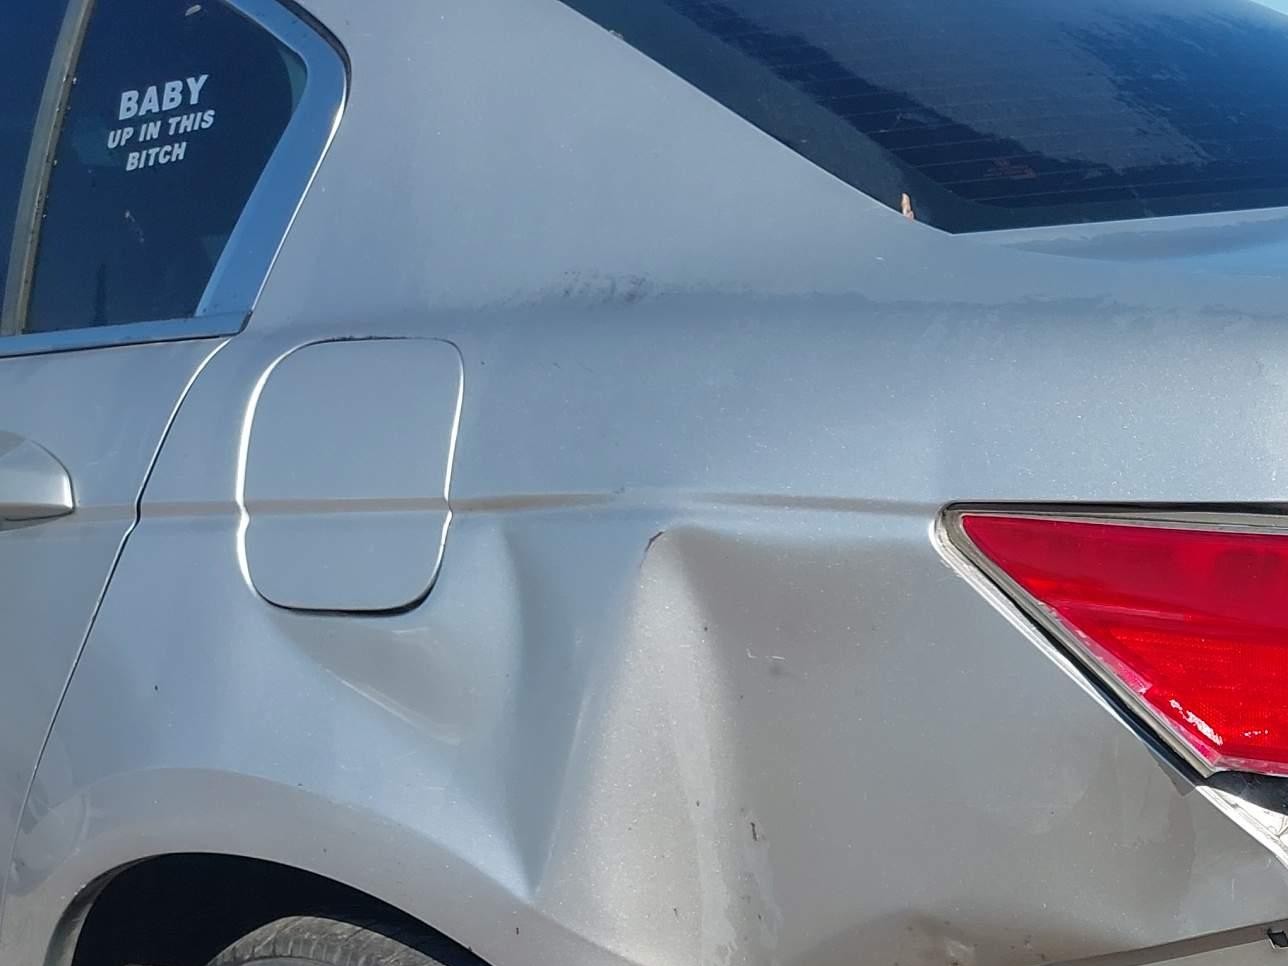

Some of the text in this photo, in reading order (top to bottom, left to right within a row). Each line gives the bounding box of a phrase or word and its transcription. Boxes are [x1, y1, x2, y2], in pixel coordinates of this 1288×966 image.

[118, 74, 209, 120] BABY
[106, 109, 216, 149] UP IN THIS
[125, 142, 187, 171] BITCH
